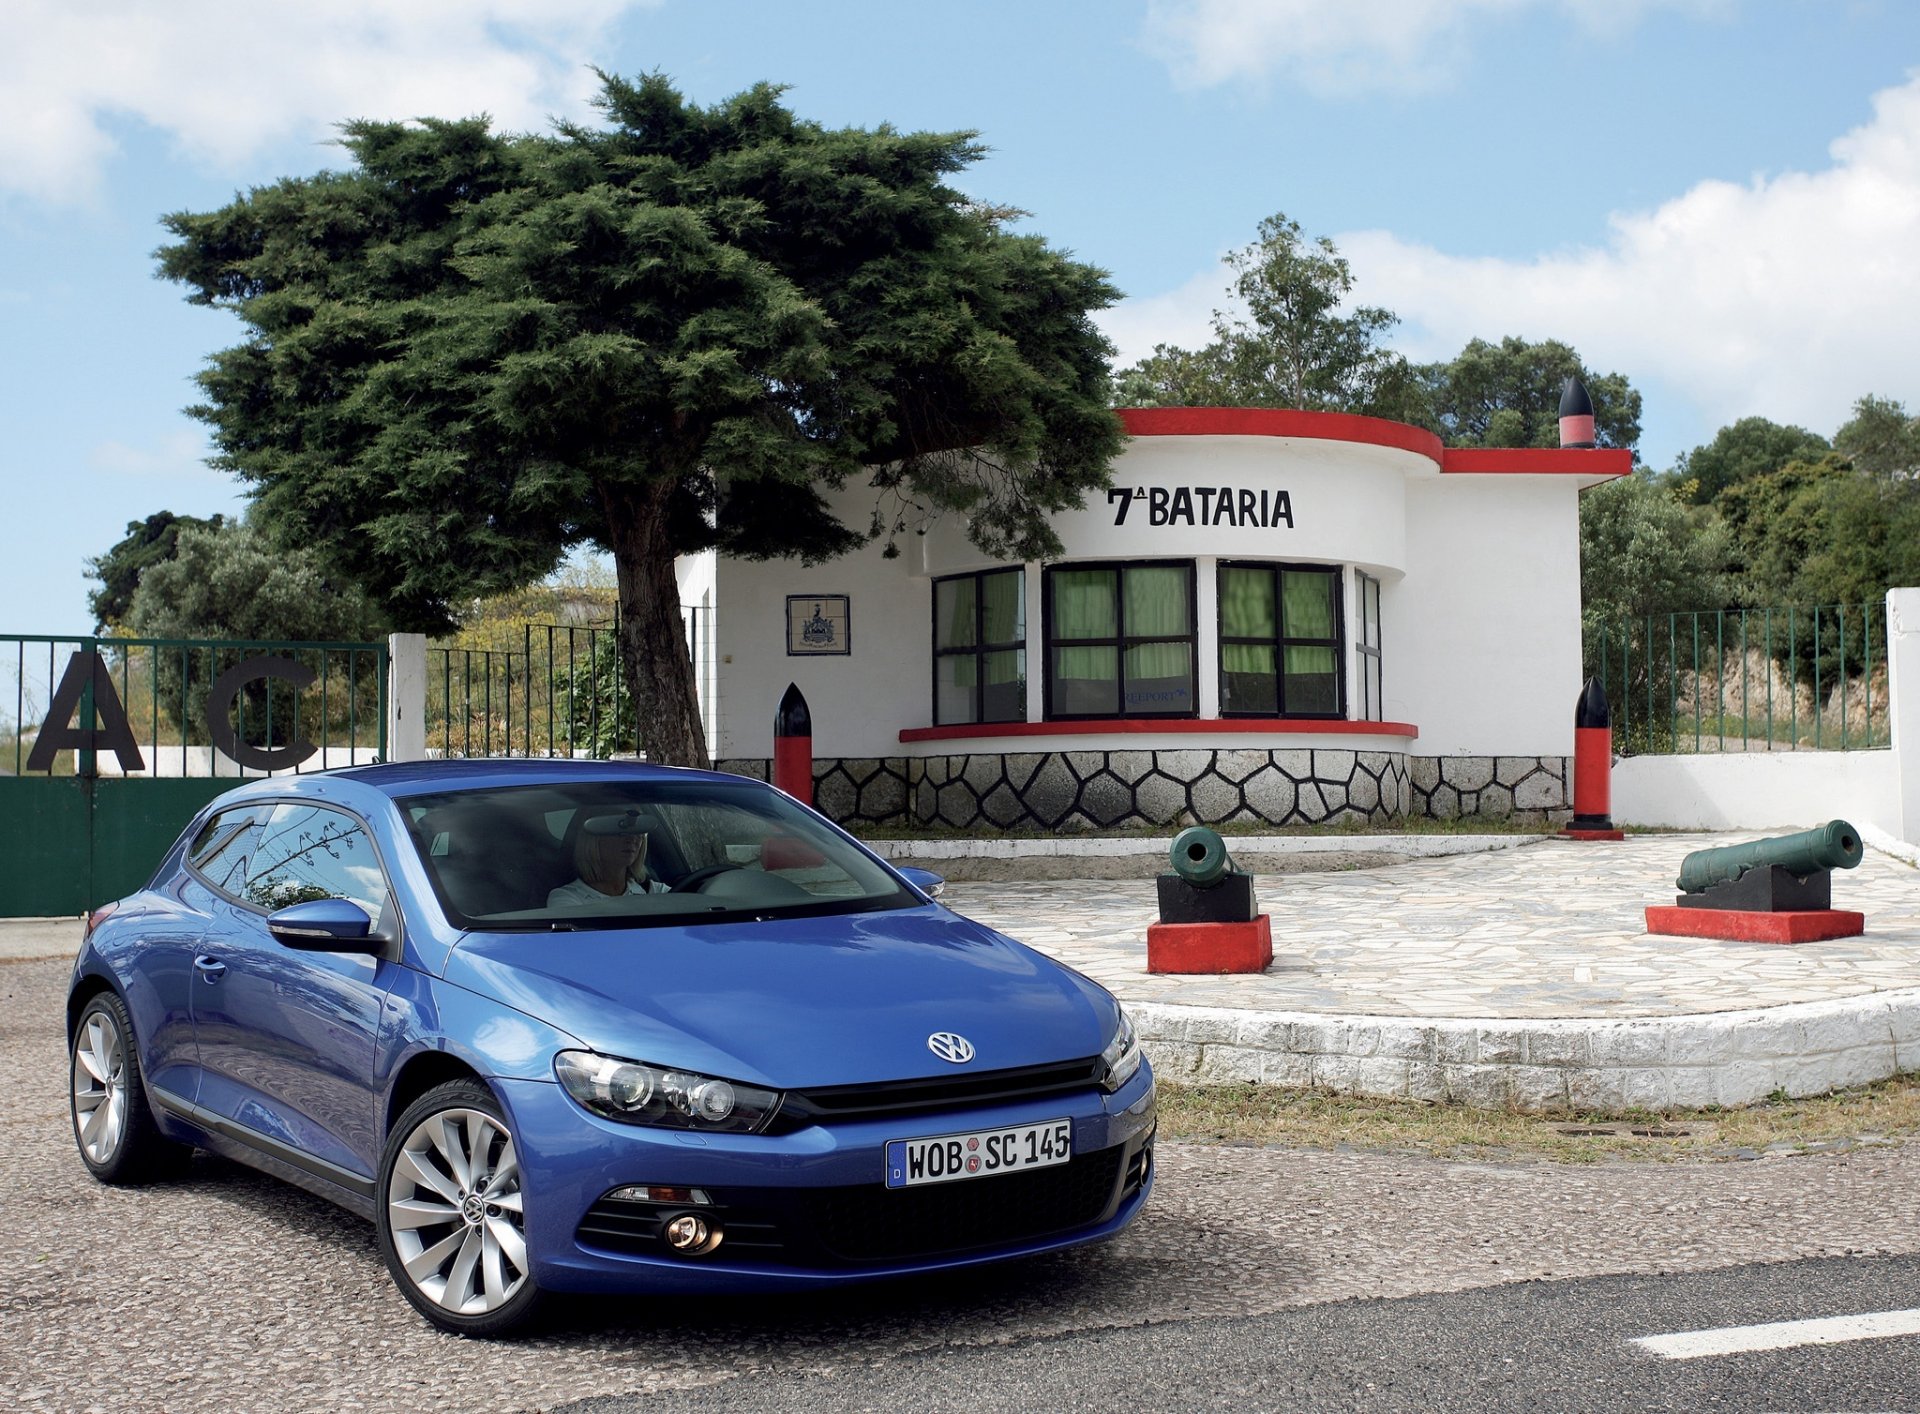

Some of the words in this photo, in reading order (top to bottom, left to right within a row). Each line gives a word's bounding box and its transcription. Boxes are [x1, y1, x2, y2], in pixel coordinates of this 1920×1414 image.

[1149, 486, 1294, 529] BATARIA
[26, 651, 146, 771] A
[206, 655, 319, 771] C
[893, 1168, 901, 1179] D
[908, 1141, 963, 1179] WOB
[985, 1133, 1017, 1170] SC
[1024, 1125, 1070, 1164] 145
